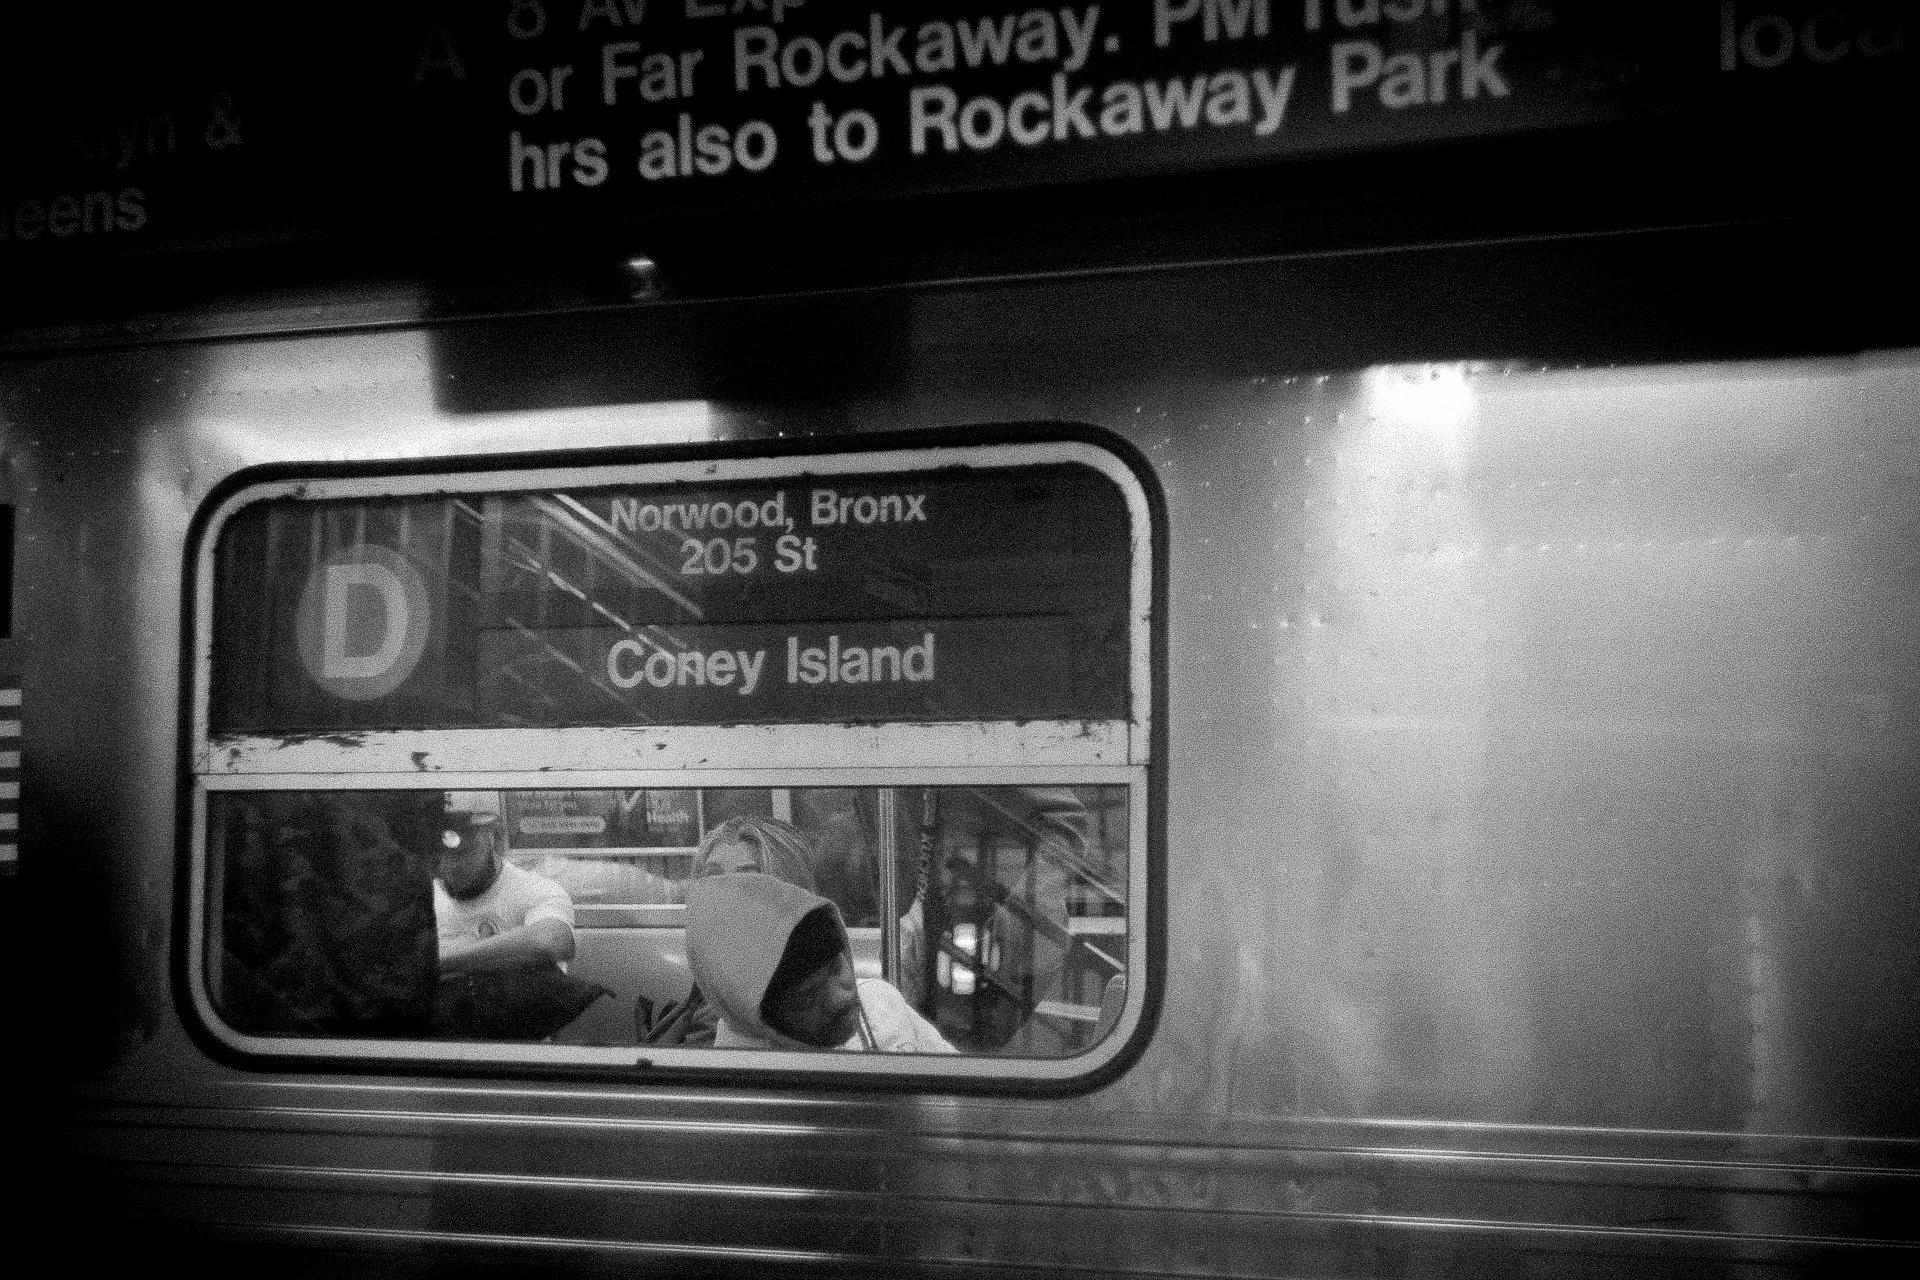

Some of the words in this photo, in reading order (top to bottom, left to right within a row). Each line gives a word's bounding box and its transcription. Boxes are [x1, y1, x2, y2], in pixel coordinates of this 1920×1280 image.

[508, 65, 573, 116] or
[601, 41, 704, 106] Far
[732, 4, 1123, 93] Rockaway.
[509, 131, 610, 191] hrs
[637, 110, 778, 181] also
[807, 99, 879, 165] to
[909, 66, 1298, 155] Rockaway
[1330, 29, 1511, 114] Park
[609, 492, 795, 533] Norwood,
[810, 490, 928, 526] Bronx
[679, 537, 758, 576] 205
[774, 534, 818, 575] St
[325, 564, 412, 679] D
[606, 637, 766, 695] Coney
[786, 632, 936, 686] Island
